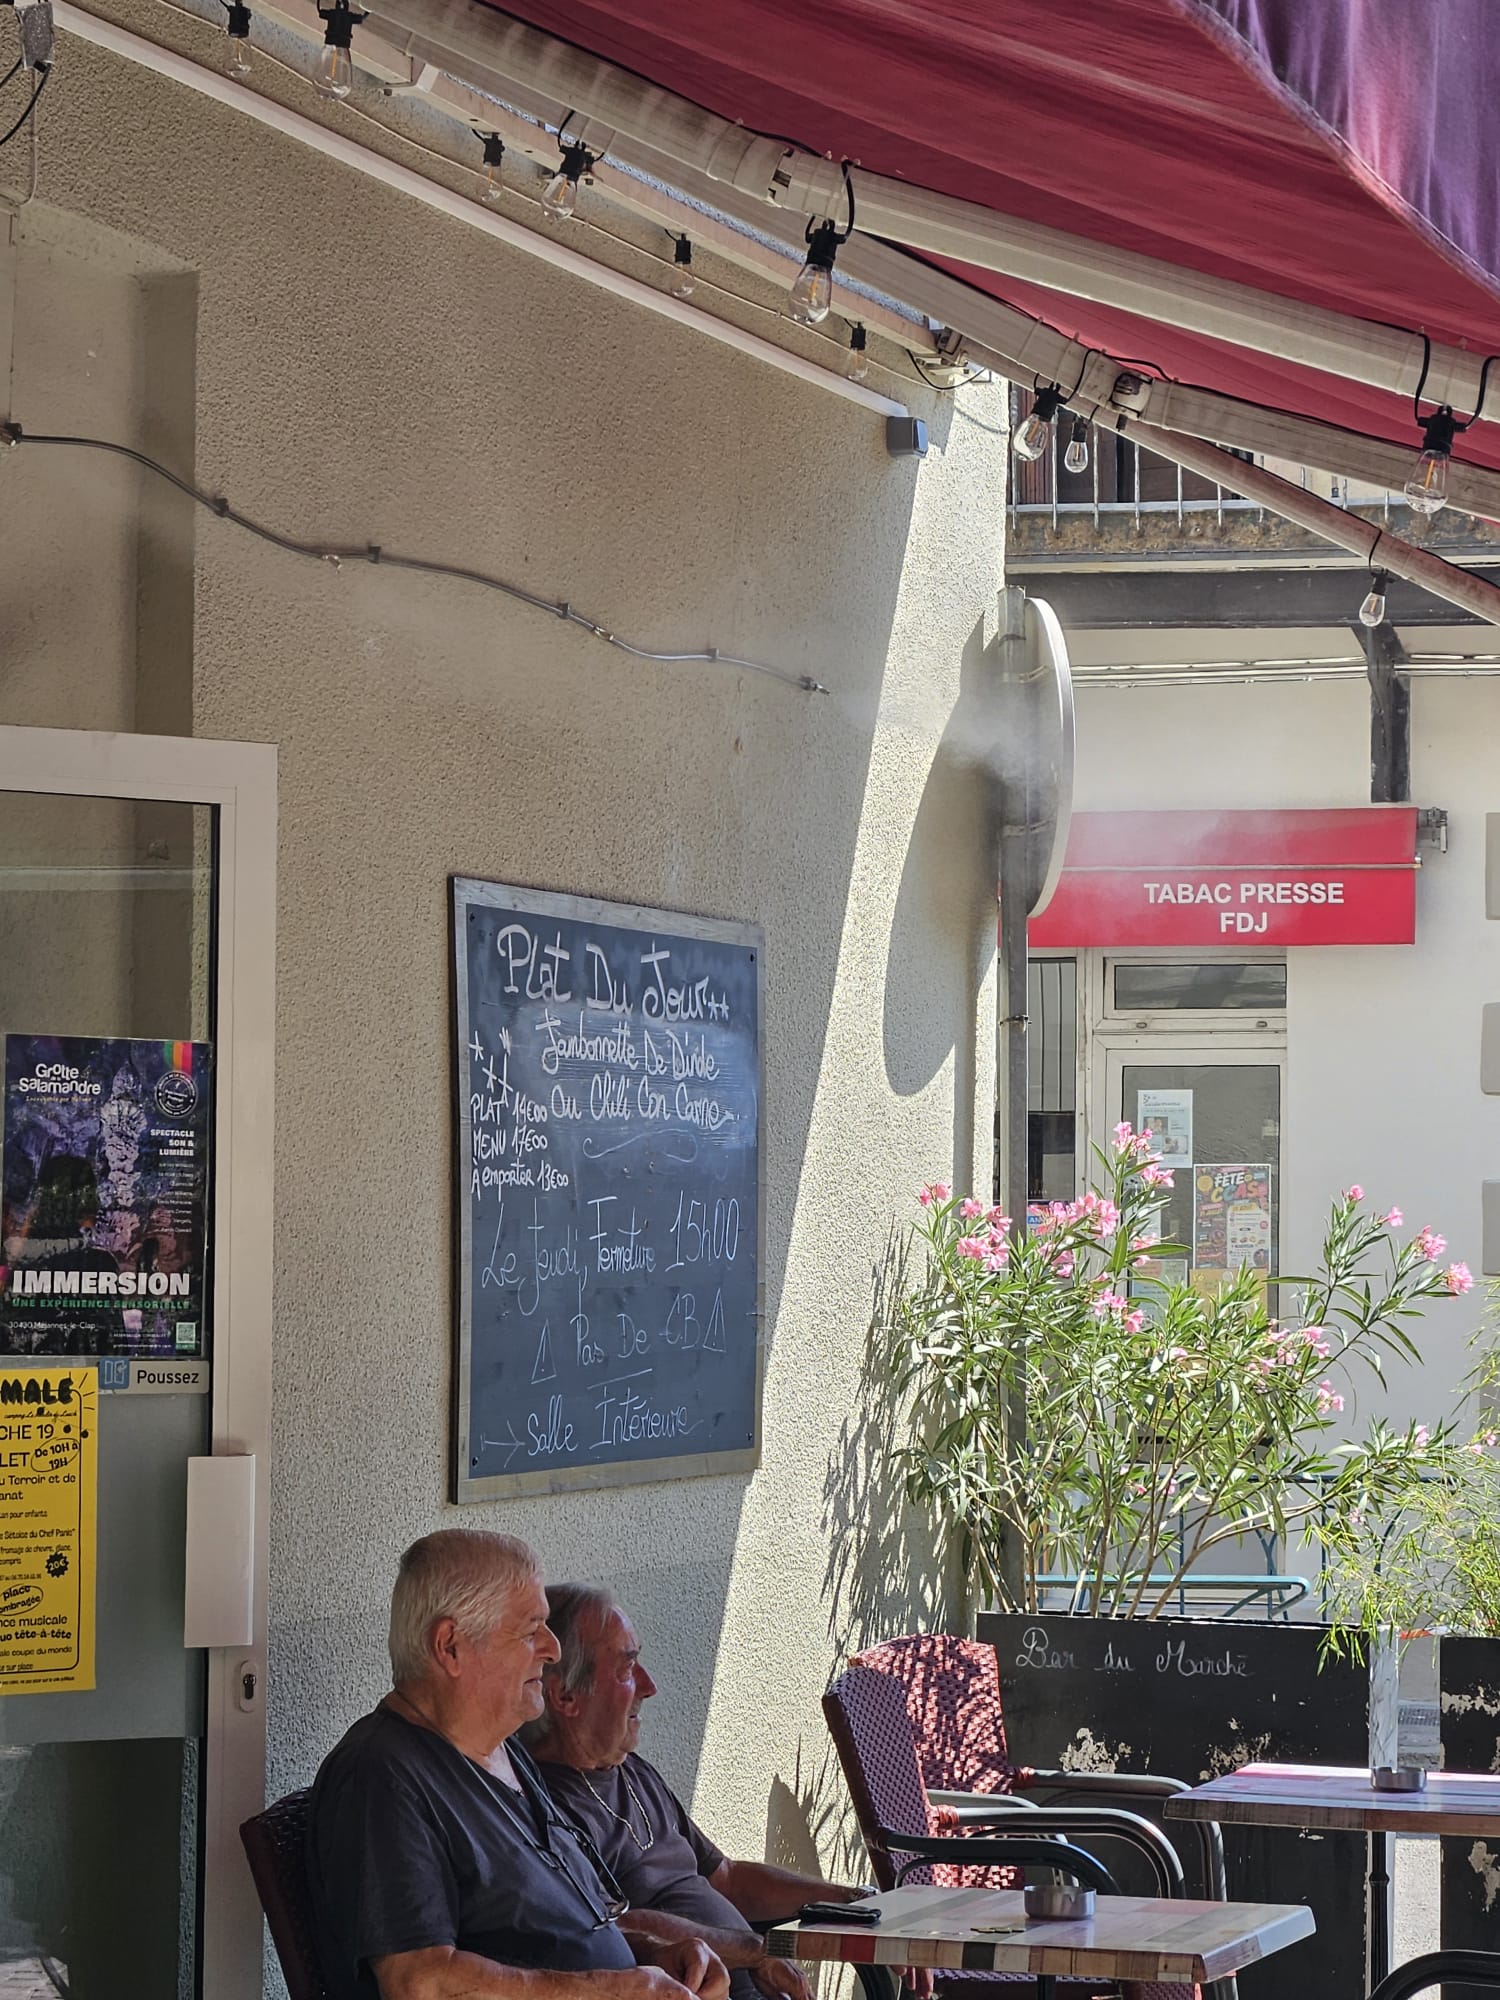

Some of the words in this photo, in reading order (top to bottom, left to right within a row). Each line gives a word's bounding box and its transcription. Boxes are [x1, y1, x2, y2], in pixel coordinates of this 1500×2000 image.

[1143, 882, 1232, 904] TABAC
[1240, 882, 1345, 904] PRESSE
[1220, 912, 1268, 933] FDJ
[497, 924, 572, 1003] Plat
[586, 943, 634, 1015] Du
[644, 1029, 668, 1075] De
[666, 1028, 720, 1081] Dinde
[35, 1063, 79, 1080] Grotte
[19, 1077, 101, 1095] Salamandre
[551, 1085, 582, 1120] Ou
[590, 1070, 631, 1121] Chili
[637, 1075, 671, 1121] Con
[471, 1093, 504, 1125] PLAT
[512, 1091, 548, 1124] 14€00
[150, 1129, 195, 1137] SPECTACLE
[168, 1139, 186, 1147] SON
[473, 1127, 506, 1160] MENU
[512, 1124, 548, 1157] 17€00
[482, 1202, 520, 1288] Le
[665, 1190, 740, 1271] 15h00
[12, 1270, 190, 1295] IMMERSION
[12, 1298, 36, 1307] UNE
[617, 1313, 651, 1358] De
[137, 1370, 200, 1384] Poussez
[36, 1424, 54, 1439] 19
[527, 1394, 578, 1456] Salle
[49, 1442, 70, 1455] 10H
[8, 1474, 45, 1485] Terroir
[48, 1475, 60, 1483] et
[63, 1473, 76, 1483] de
[48, 1558, 66, 1571] 20€
[19, 1614, 68, 1627] musicale
[1016, 1627, 1080, 1669] Bar
[1094, 1641, 1135, 1672] du
